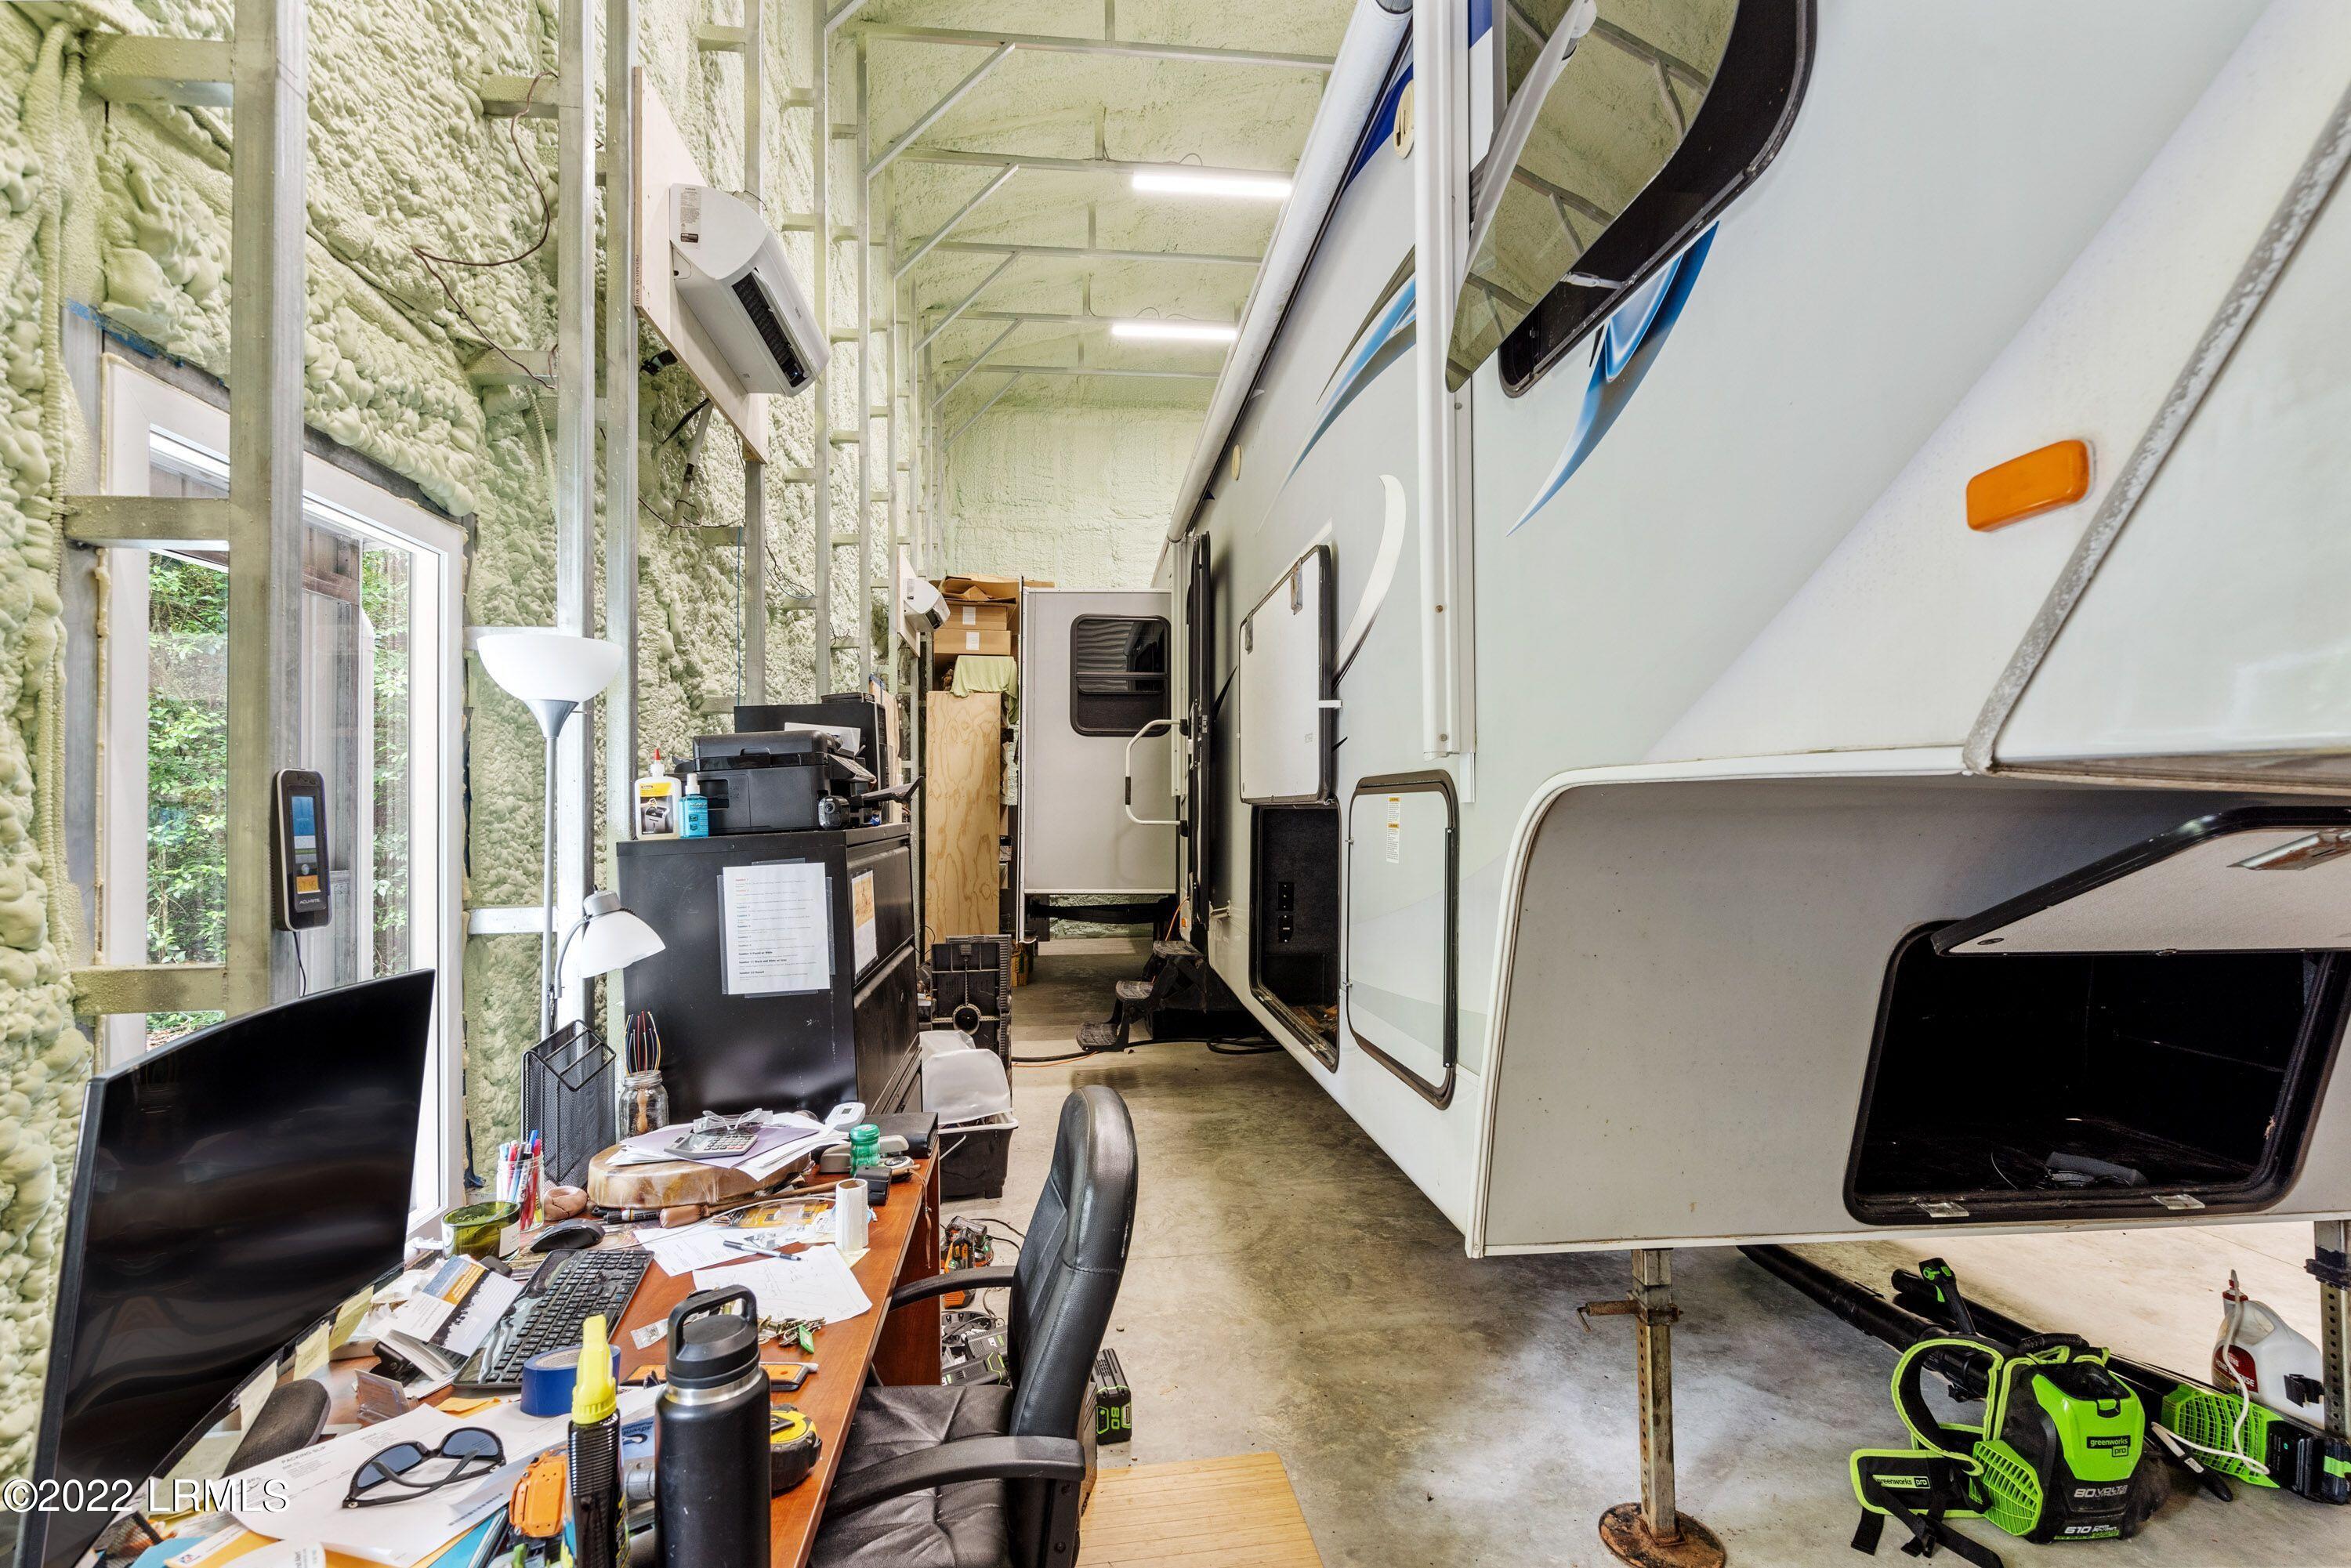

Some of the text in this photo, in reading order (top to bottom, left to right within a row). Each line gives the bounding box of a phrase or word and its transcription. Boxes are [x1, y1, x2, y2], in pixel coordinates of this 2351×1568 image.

[1110, 1407, 1121, 1429] 80
[2090, 1437, 2128, 1447] greenworks
[2114, 1447, 2127, 1456] pro
[2074, 1488, 2096, 1497] 80
[2064, 1526, 2092, 1534] 610
